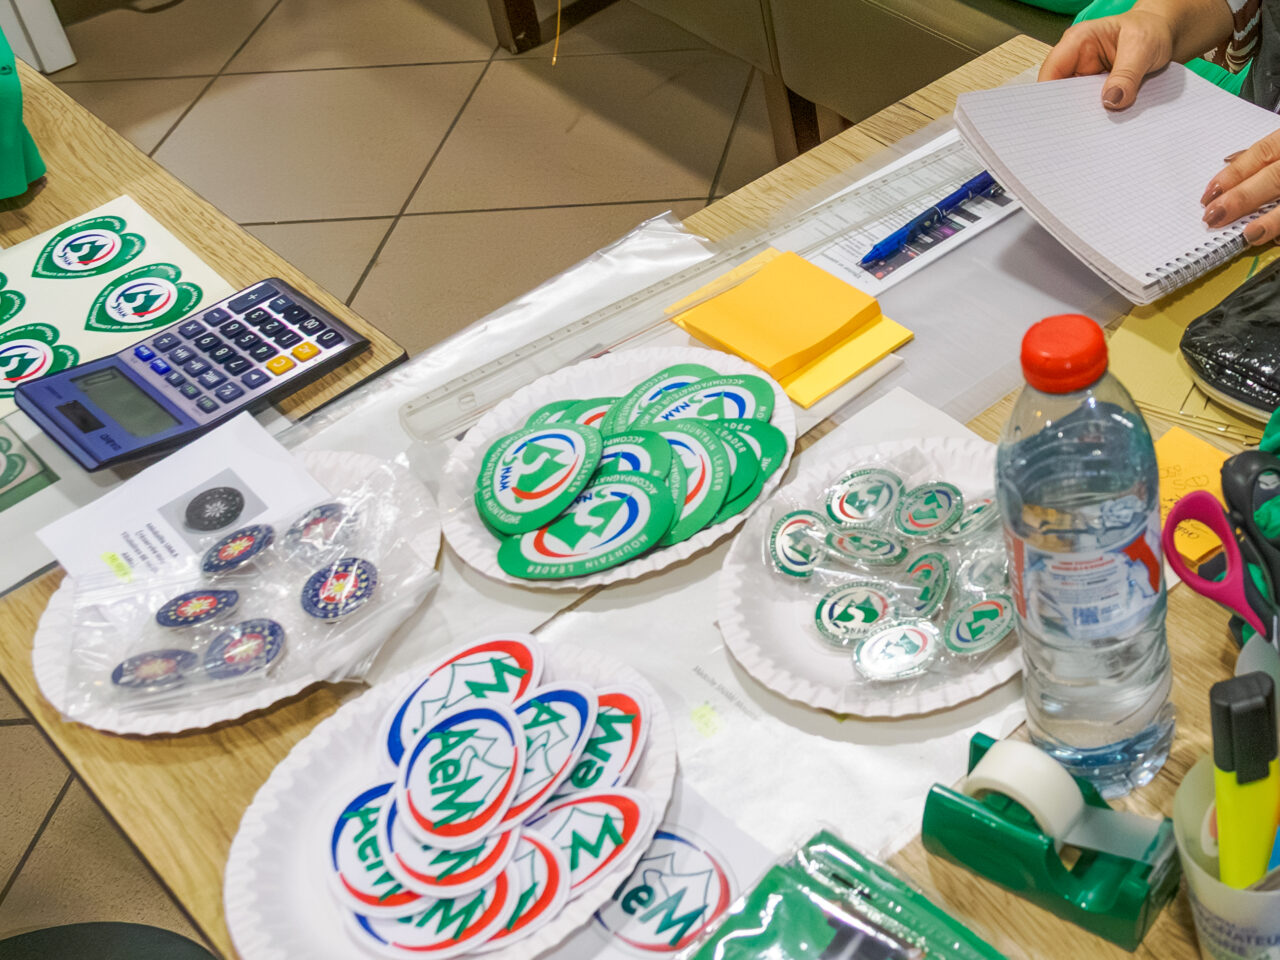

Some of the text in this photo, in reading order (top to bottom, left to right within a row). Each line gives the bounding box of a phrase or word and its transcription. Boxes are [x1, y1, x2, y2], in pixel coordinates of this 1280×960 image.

[677, 423, 724, 492] MOUNTAIN LEADER
[715, 427, 747, 453] LEADER
[527, 533, 649, 575] MOUNTAIN LEADER
[427, 728, 485, 829] AeM
[571, 713, 638, 789] eM
[621, 884, 709, 946] eM
